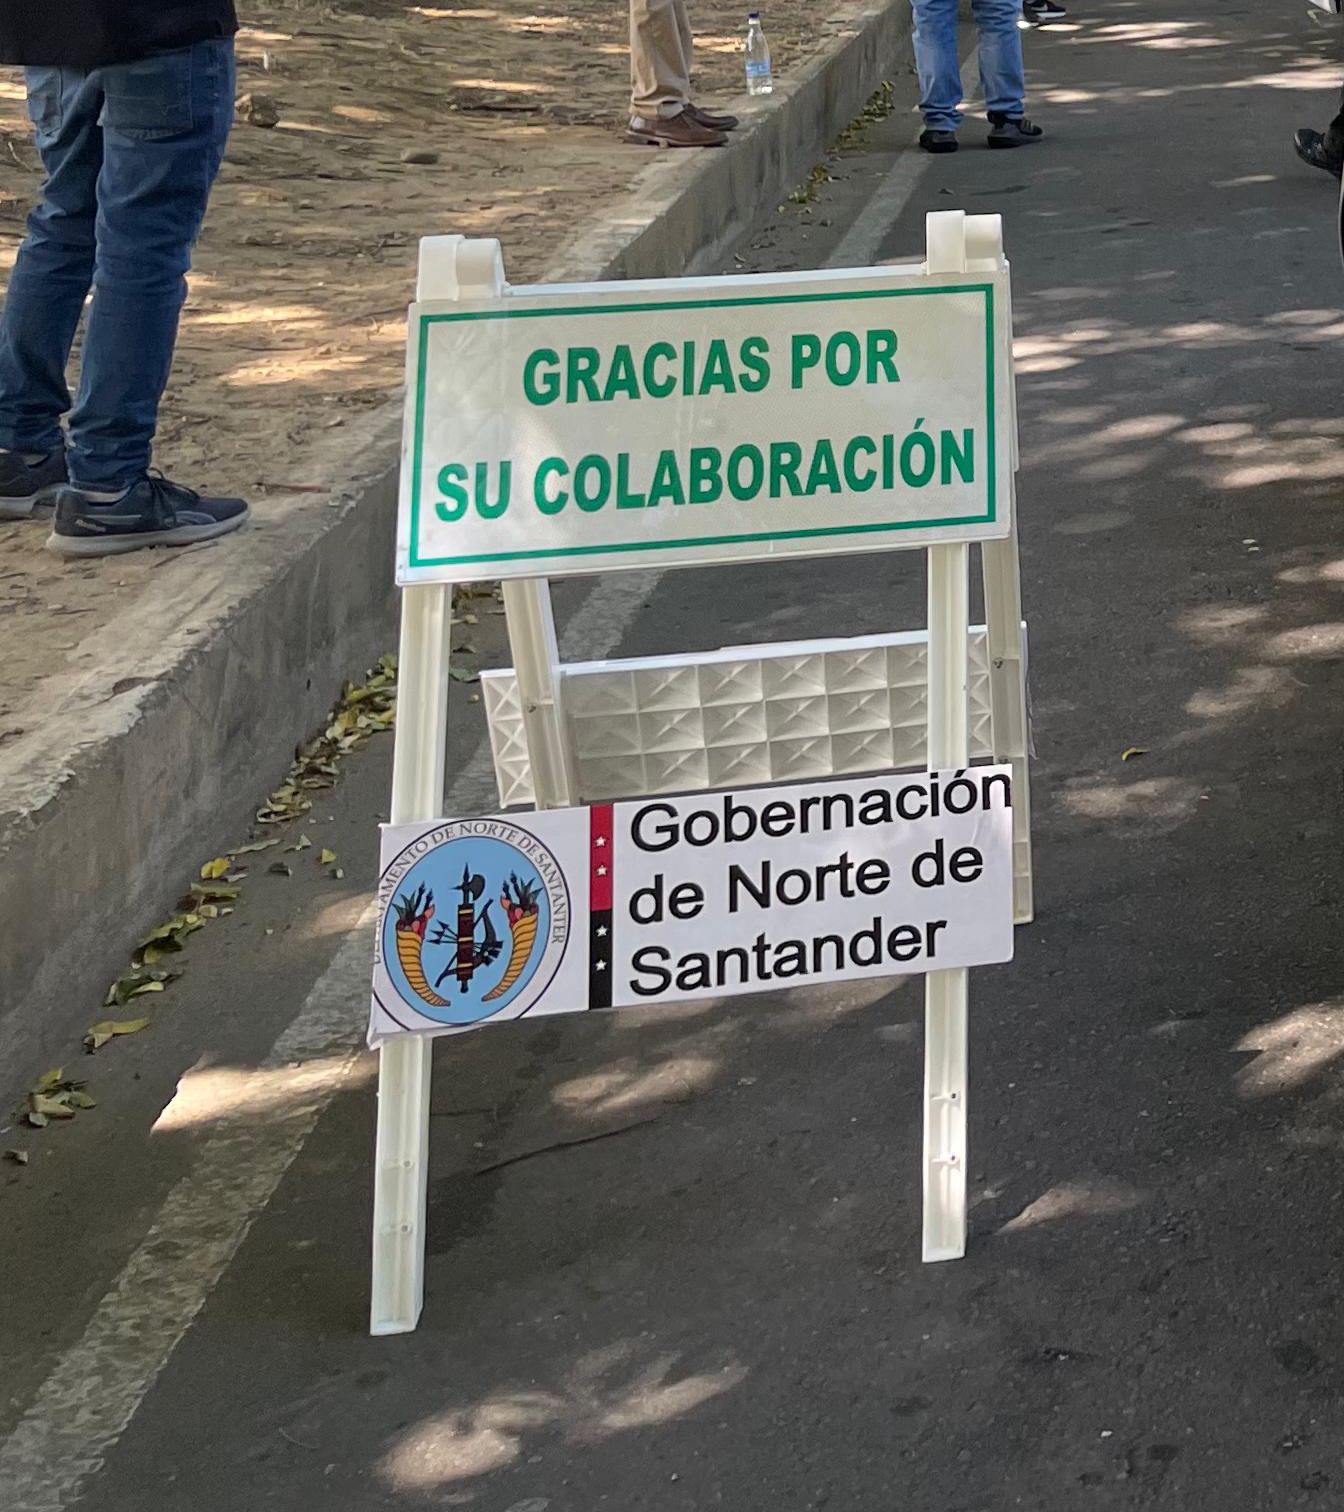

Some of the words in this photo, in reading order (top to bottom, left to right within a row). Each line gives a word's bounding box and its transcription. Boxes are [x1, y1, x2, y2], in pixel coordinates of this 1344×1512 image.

[523, 336, 770, 406] GRACIAS
[792, 329, 900, 389] POR
[435, 461, 510, 522] SU
[534, 418, 976, 516] COLABORACIÓN
[432, 826, 456, 844] DE
[460, 822, 517, 840] NORTE
[518, 836, 538, 856] DE
[629, 768, 1012, 852] Gobernación
[629, 874, 704, 925] de
[729, 851, 890, 913] Norte
[912, 839, 983, 888] de
[629, 916, 947, 996] Santander
